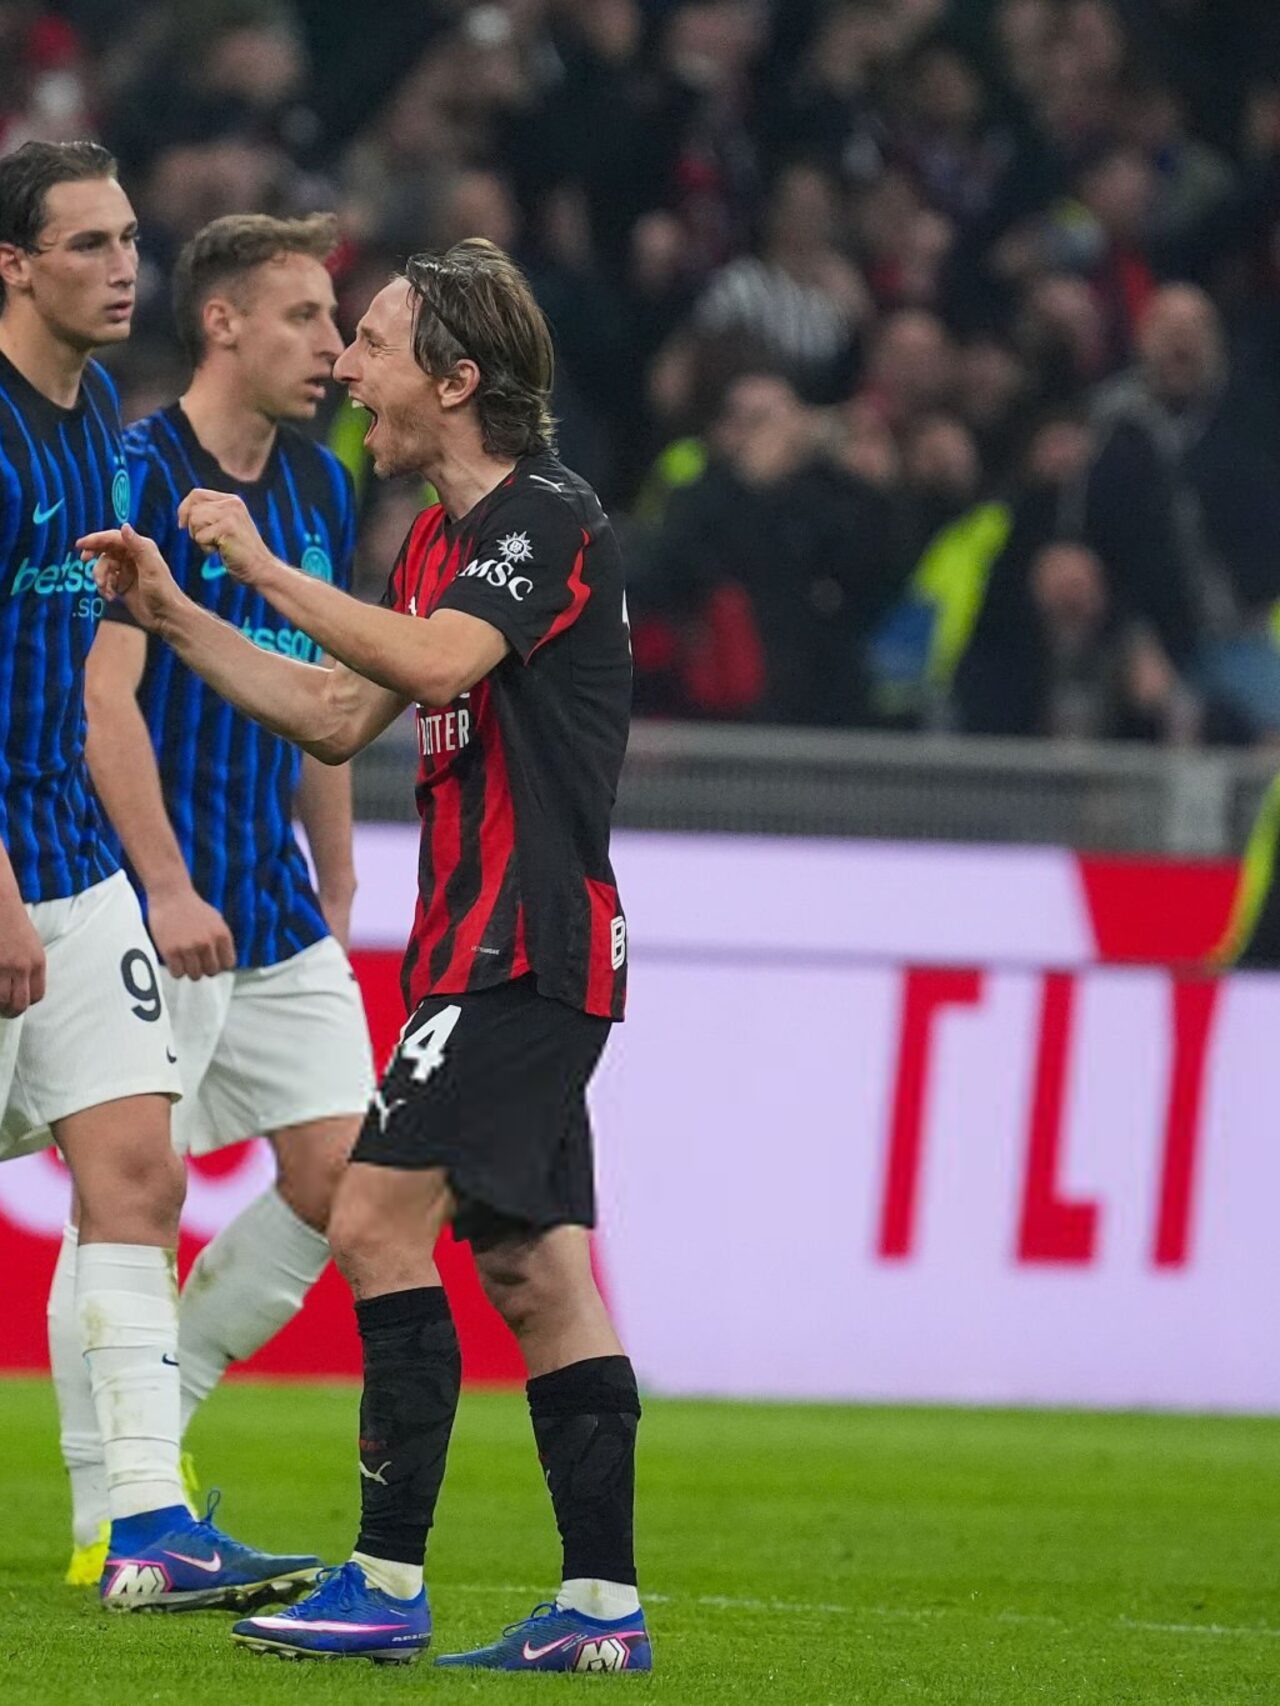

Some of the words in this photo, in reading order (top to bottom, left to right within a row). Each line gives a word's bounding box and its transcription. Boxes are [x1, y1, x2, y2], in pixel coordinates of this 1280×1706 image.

[9, 551, 98, 596] betss
[456, 557, 534, 602] MSC
[120, 947, 162, 1023] 9
